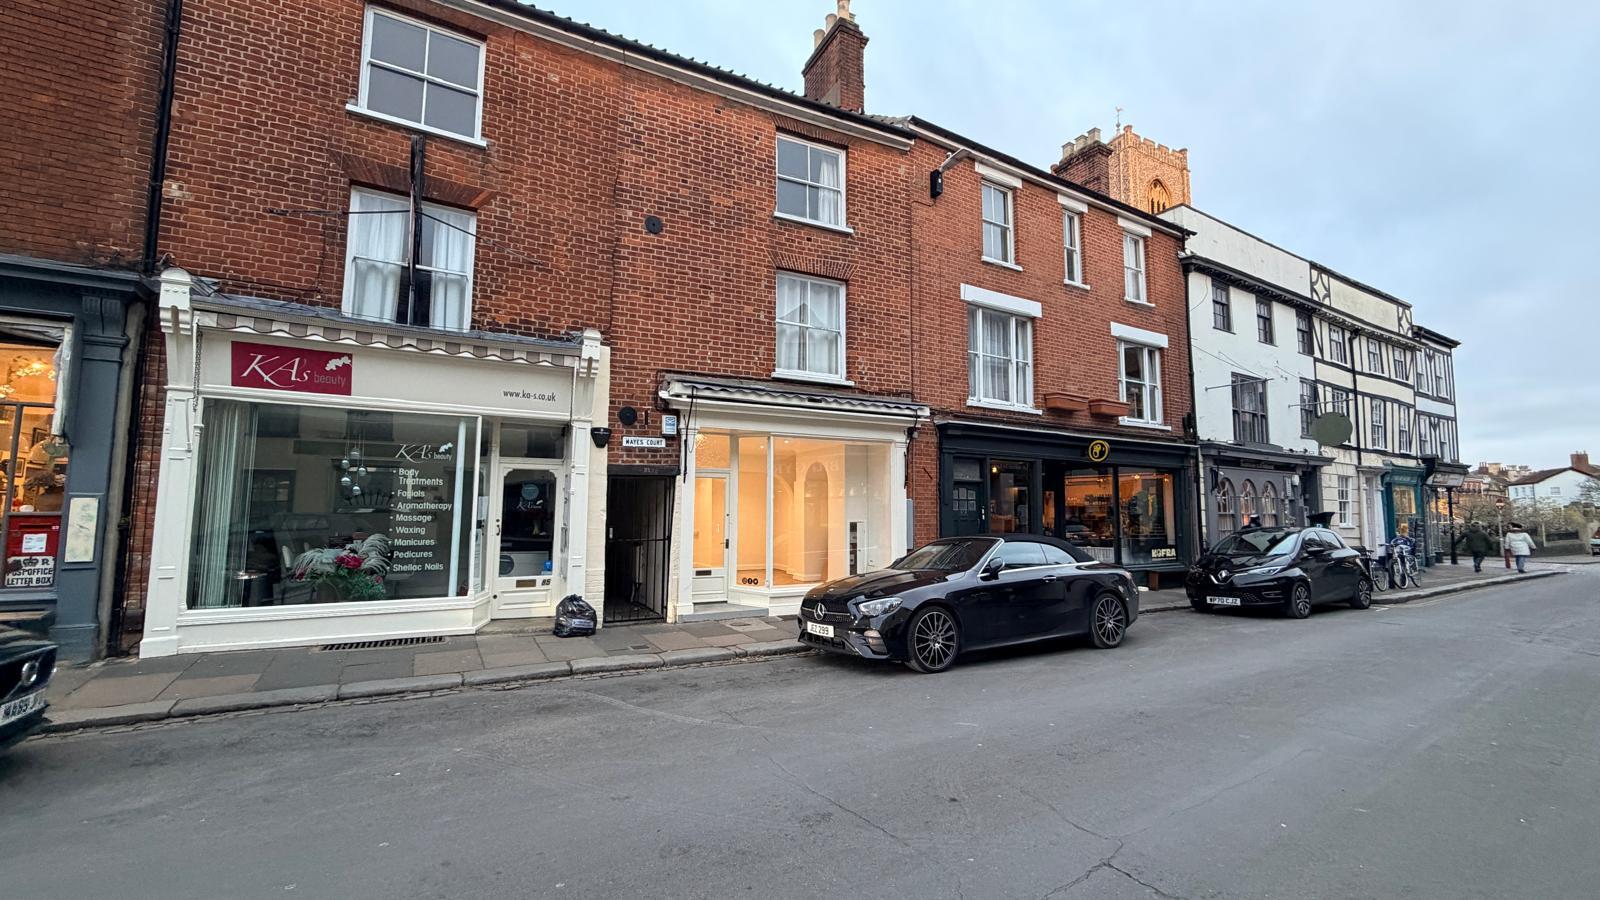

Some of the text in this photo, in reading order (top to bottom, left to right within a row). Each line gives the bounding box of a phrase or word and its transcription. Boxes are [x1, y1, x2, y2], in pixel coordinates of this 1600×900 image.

[314, 372, 347, 387] beauty
[503, 389, 556, 402] www.ka-s.co.uk
[433, 452, 453, 461] beauty
[398, 468, 419, 477] Body
[399, 477, 443, 486] Treatments
[397, 489, 425, 497] Facials
[397, 502, 452, 511] Aromatherapy
[395, 514, 432, 523] Massage
[395, 526, 426, 535] Waxing
[394, 539, 435, 547] Manicures
[393, 551, 433, 559] Pedicures
[392, 563, 444, 572] Shellac Nails
[7, 577, 51, 586] LETTER BOX
